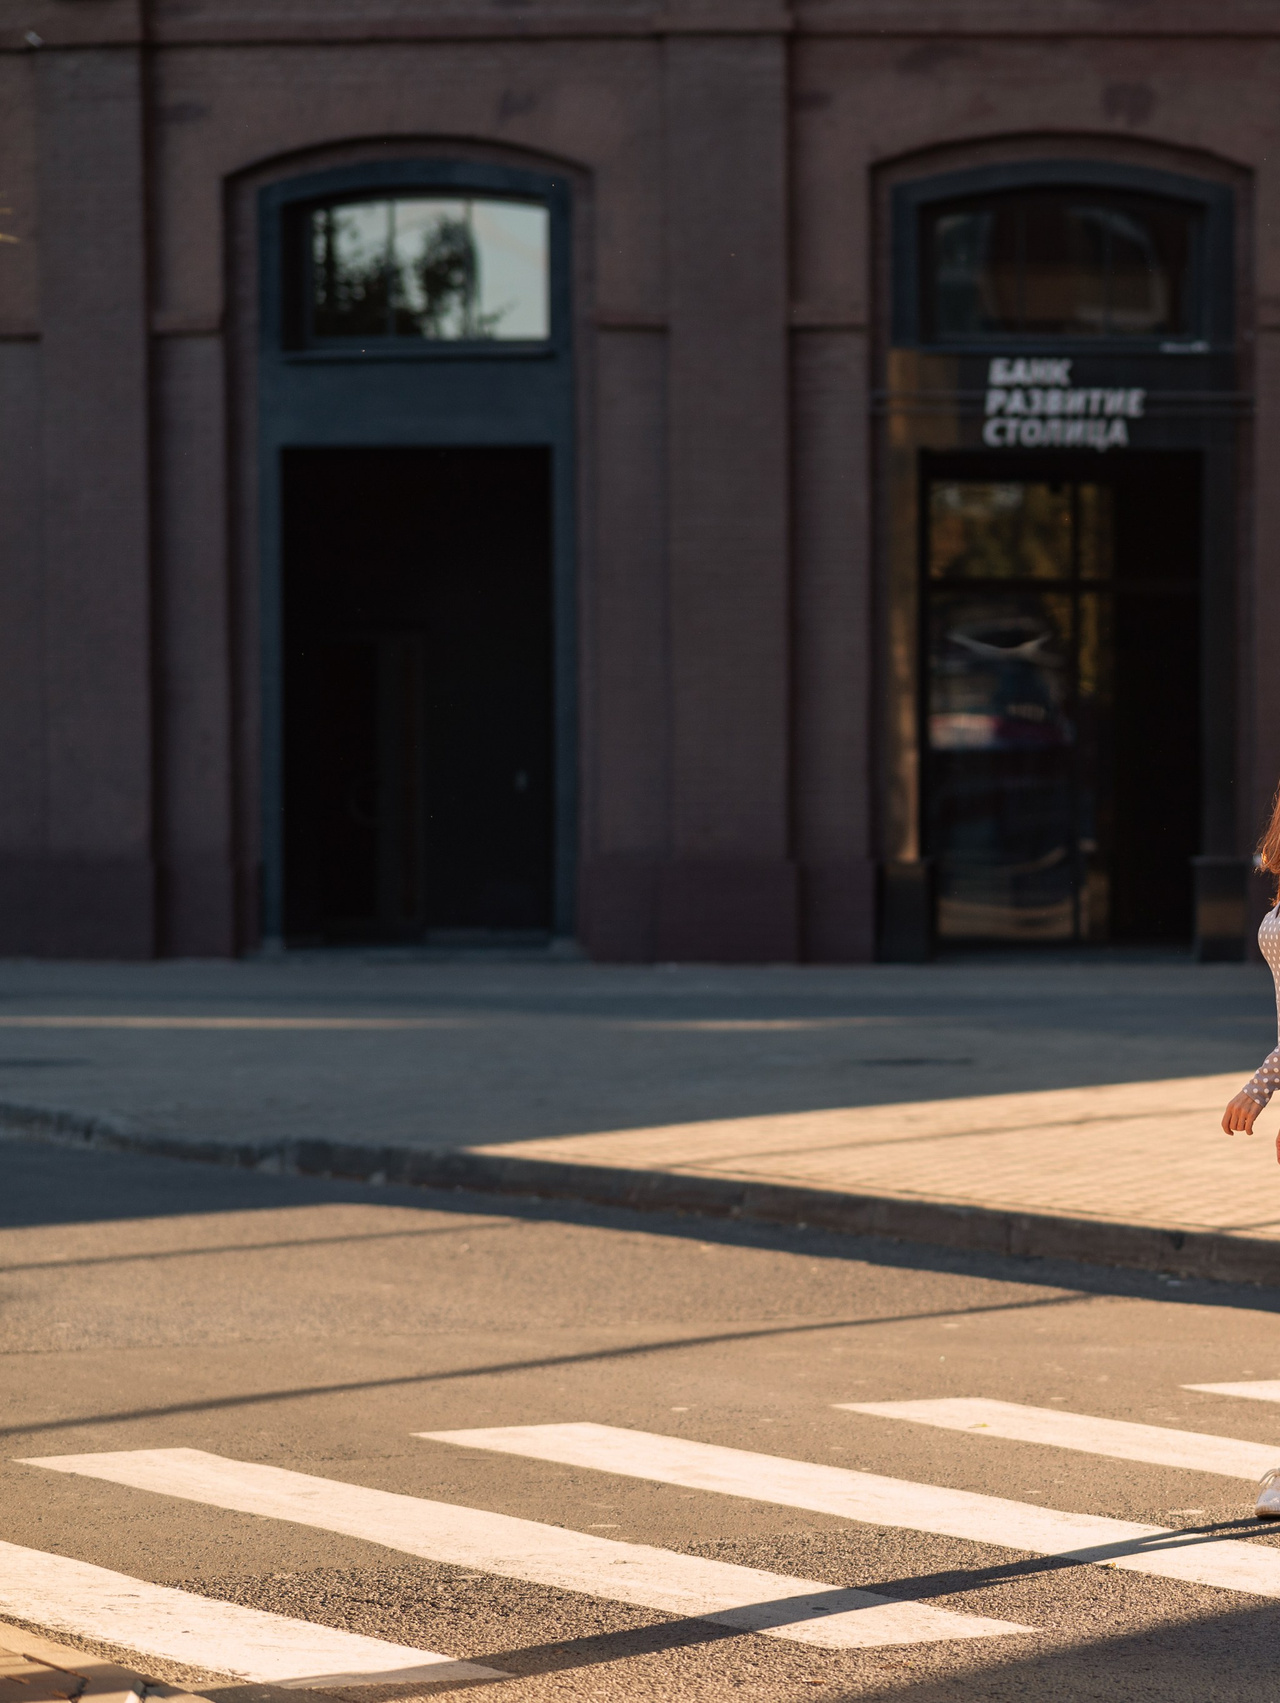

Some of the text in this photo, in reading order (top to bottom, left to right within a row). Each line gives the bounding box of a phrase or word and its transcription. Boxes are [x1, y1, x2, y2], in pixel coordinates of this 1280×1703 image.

[988, 357, 1071, 386] БАНК
[984, 388, 1145, 417] РАЗВИТИЕ
[983, 418, 1128, 451] СТОЛИЦА
